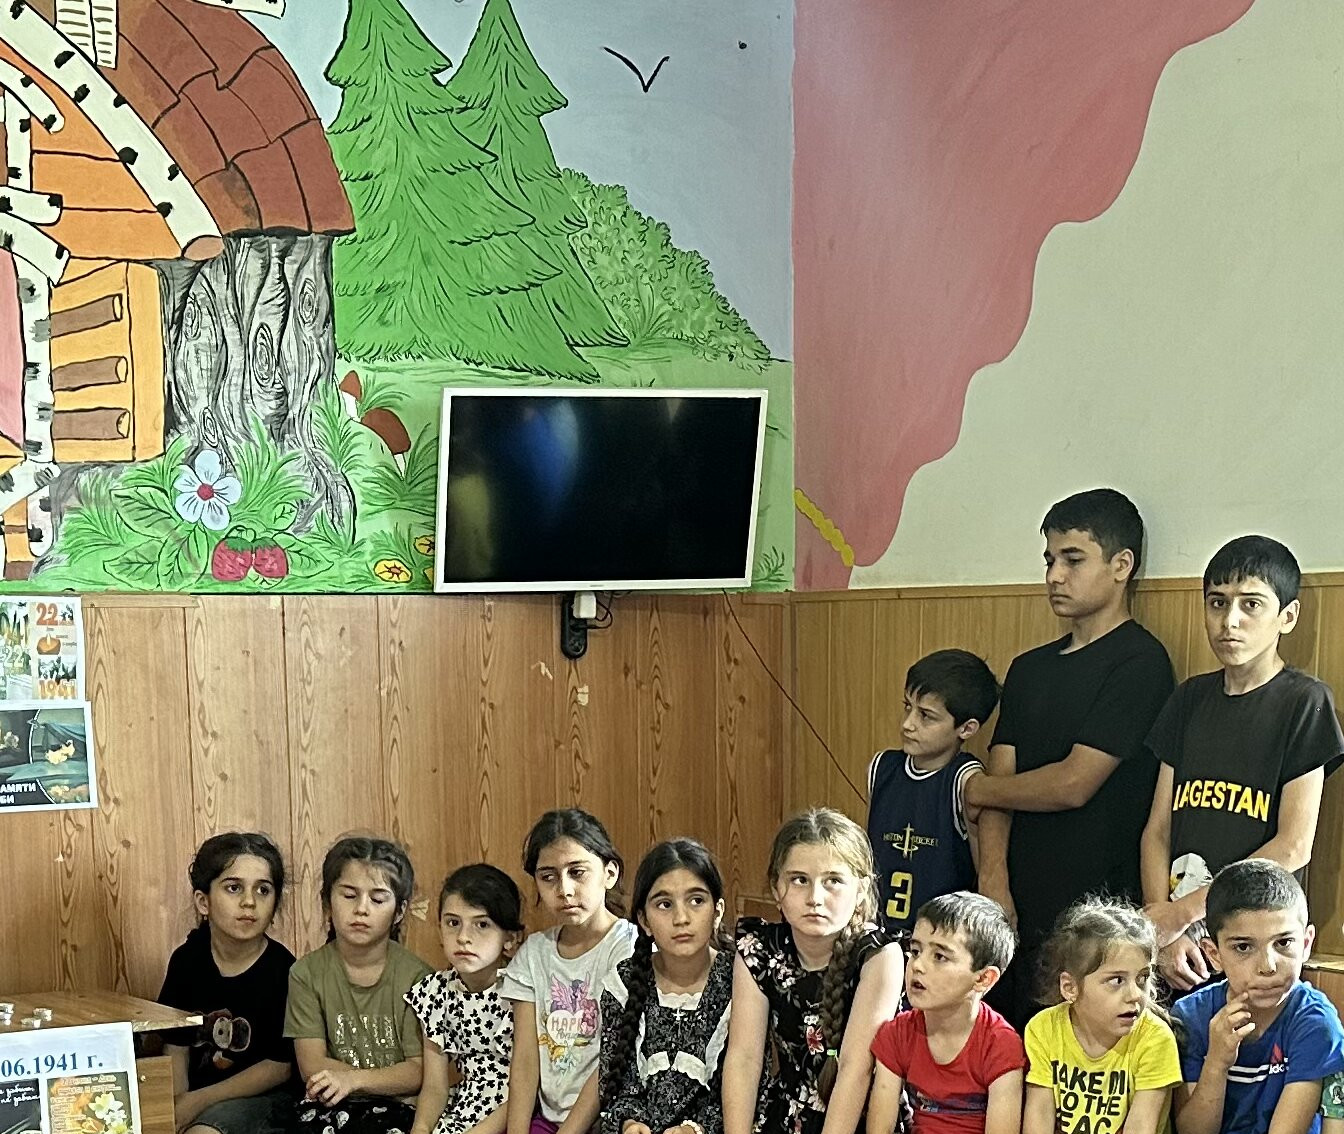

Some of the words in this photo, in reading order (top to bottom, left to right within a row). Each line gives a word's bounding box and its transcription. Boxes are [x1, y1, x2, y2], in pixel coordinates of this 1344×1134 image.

[36, 602, 58, 626] 22
[886, 871, 913, 920] 3
[87, 1053, 104, 1069] г.
[1051, 1060, 1105, 1095] TAKE
[1108, 1070, 1131, 1095] M
[1084, 1093, 1121, 1116] THE
